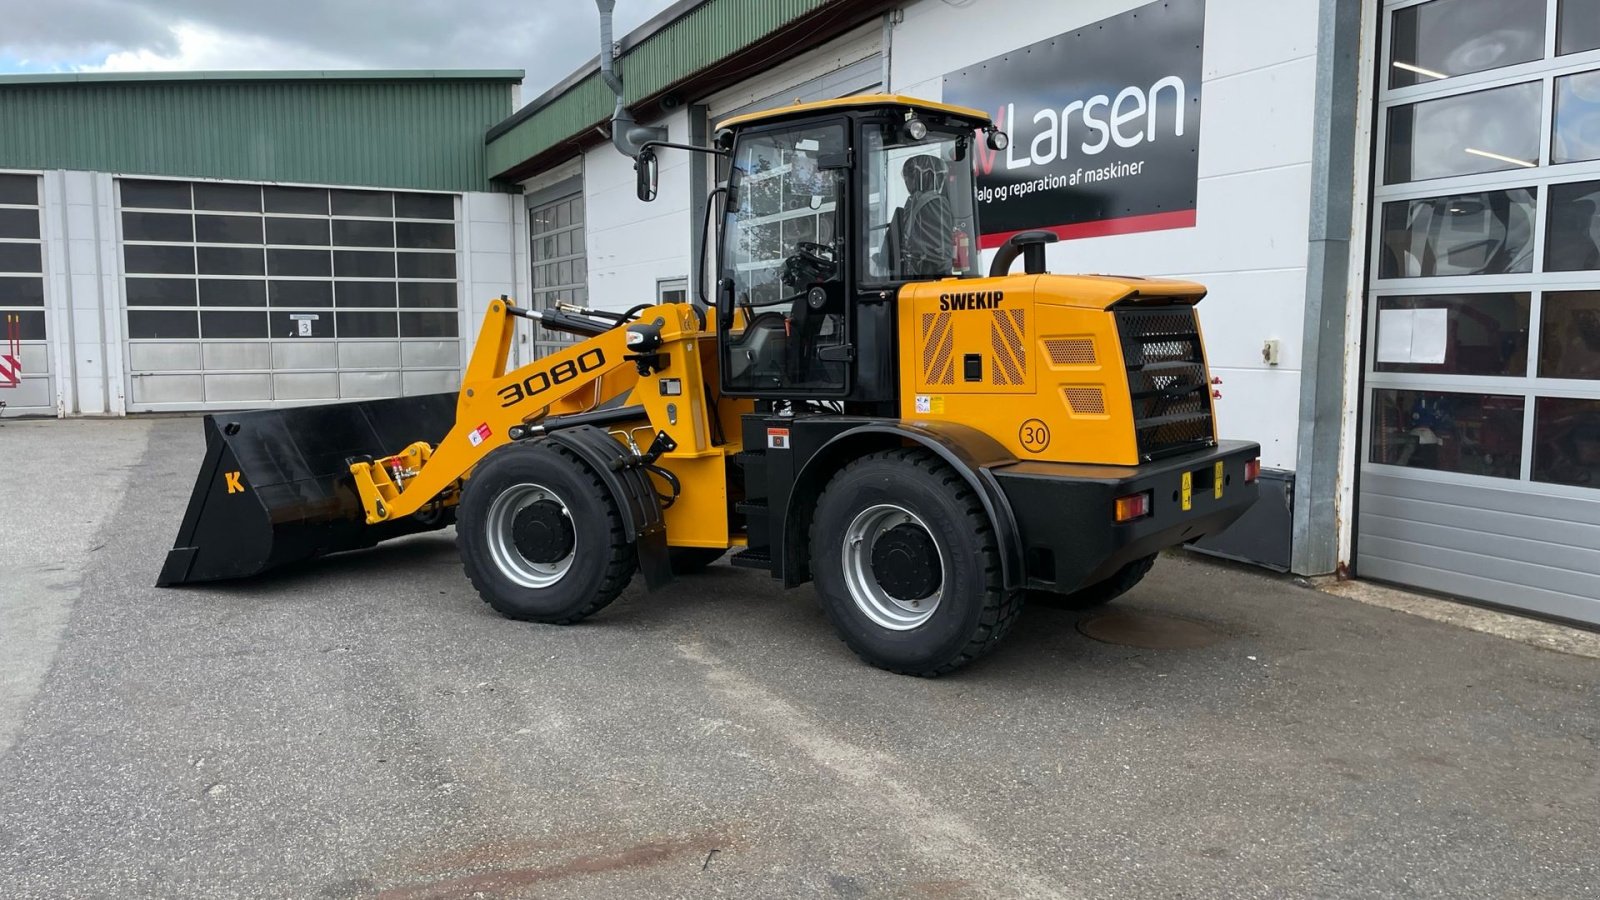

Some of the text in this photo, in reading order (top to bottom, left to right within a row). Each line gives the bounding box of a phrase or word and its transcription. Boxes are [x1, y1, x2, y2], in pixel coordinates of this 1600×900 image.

[973, 75, 1186, 177] VLarsen
[974, 160, 1145, 203] alg og reparation af maskiner
[939, 290, 1004, 312] SWEKIP
[302, 323, 309, 334] 3
[497, 347, 606, 408] 3080
[1024, 426, 1047, 445] 30
[225, 471, 245, 494] K
